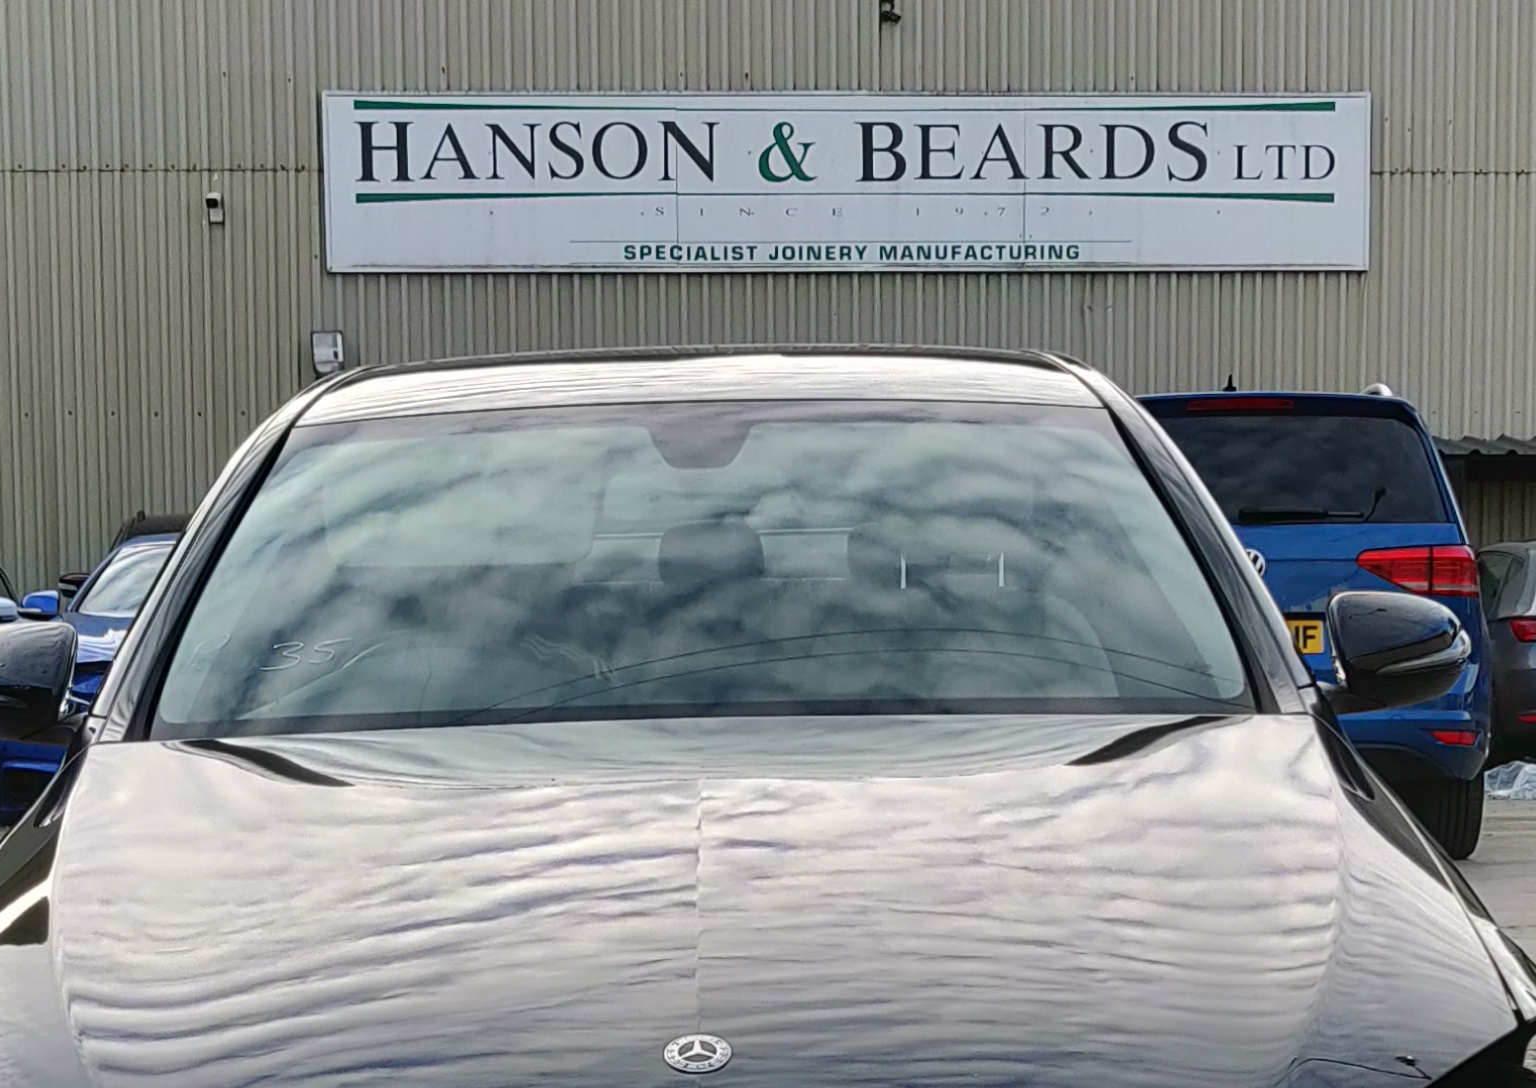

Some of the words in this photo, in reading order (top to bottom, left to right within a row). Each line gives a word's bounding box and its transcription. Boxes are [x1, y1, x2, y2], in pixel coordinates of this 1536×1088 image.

[355, 121, 720, 182] HANSON
[758, 121, 818, 182] &
[855, 121, 1208, 182] BEARDS
[1233, 144, 1336, 180] LTD
[655, 207, 843, 217] SINCE
[916, 207, 1050, 217] 1972
[624, 244, 758, 262] SPECIALIST
[768, 244, 868, 261] JOINERY
[879, 244, 1080, 261] MANUFACTURING
